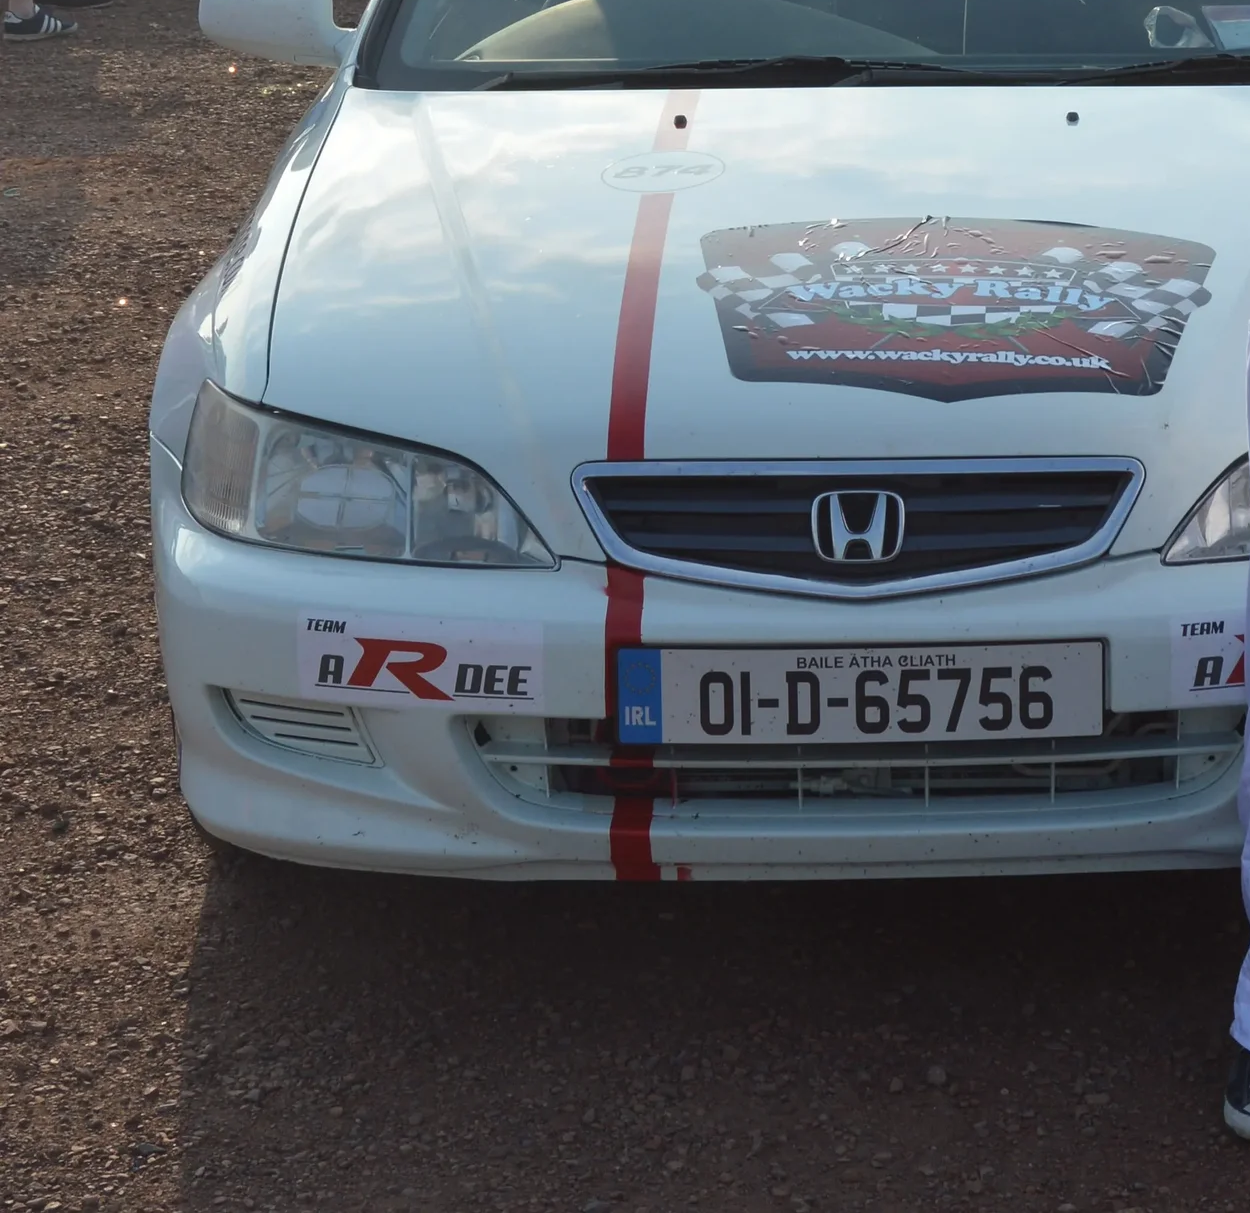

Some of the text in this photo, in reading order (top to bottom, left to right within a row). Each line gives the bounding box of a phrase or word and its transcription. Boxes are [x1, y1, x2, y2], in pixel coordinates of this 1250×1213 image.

[613, 164, 714, 179] 874
[789, 277, 1113, 310] Wacky Rally
[787, 348, 1111, 370] www.wackyrally.co.uk
[307, 618, 347, 634] TEAM
[1181, 621, 1224, 637] TEAM
[797, 657, 844, 669] BAILE
[700, 666, 1054, 736] 01-D-65756
[624, 706, 656, 726] IRL
